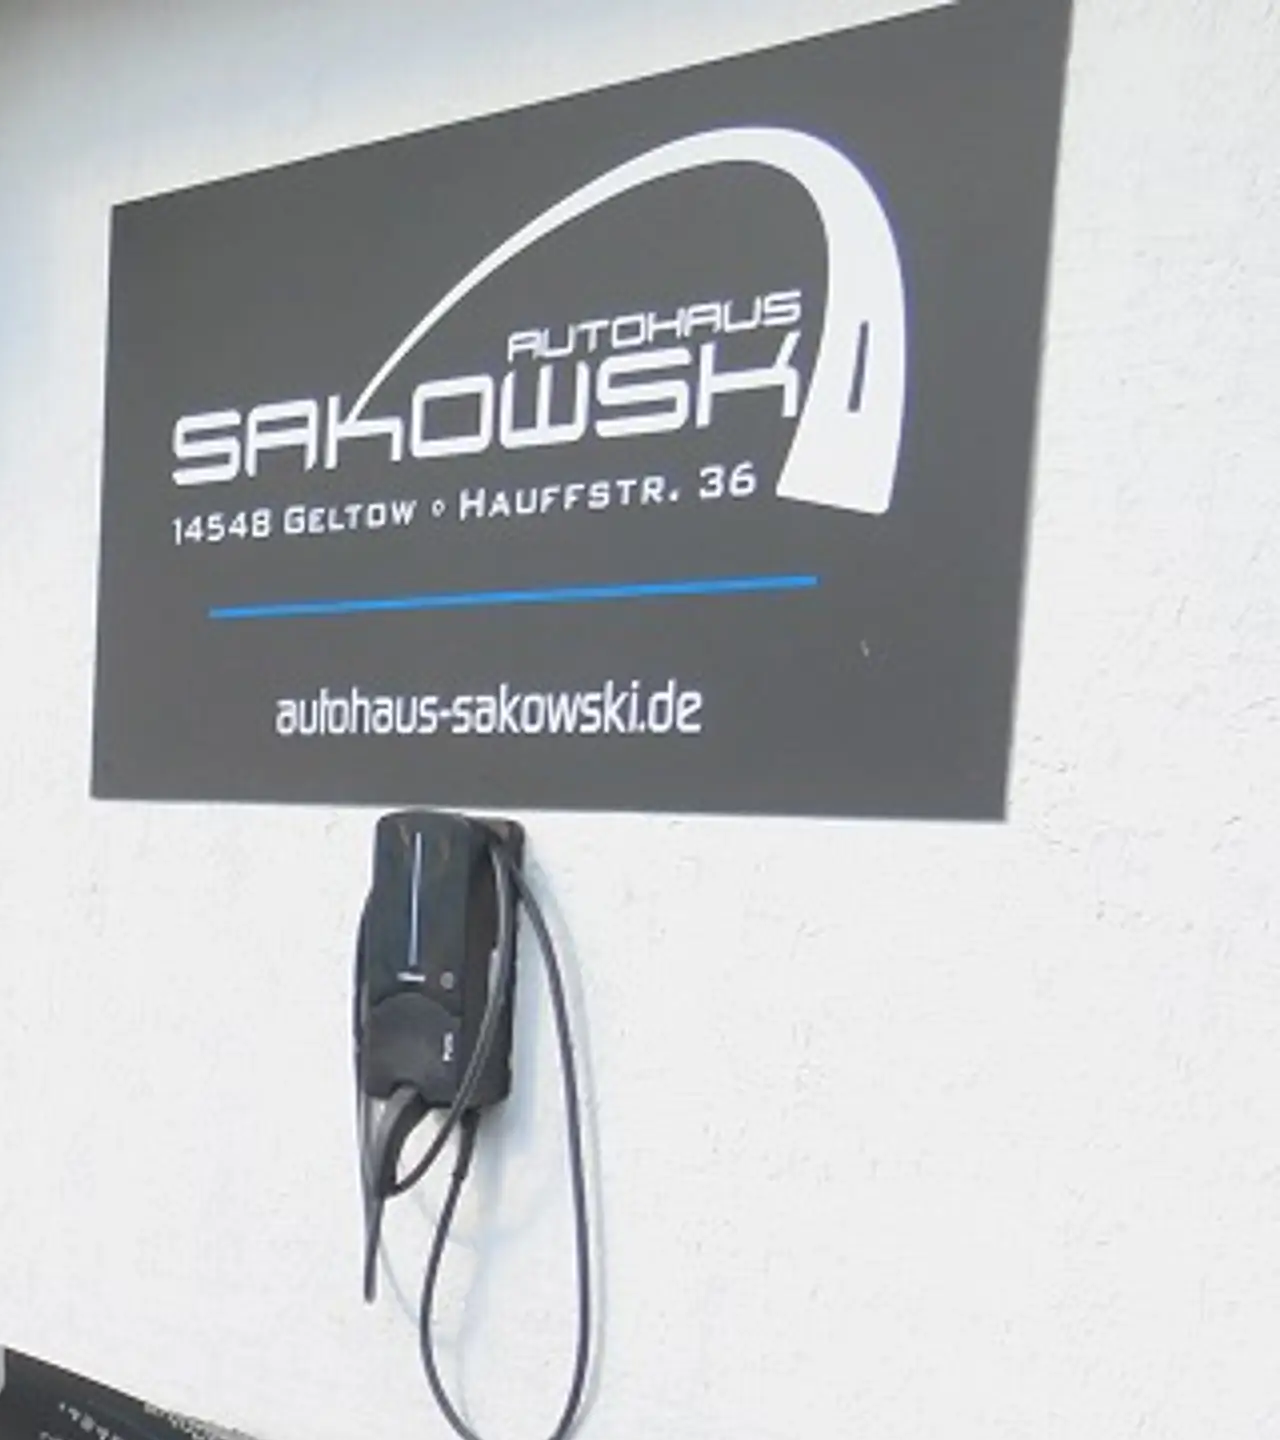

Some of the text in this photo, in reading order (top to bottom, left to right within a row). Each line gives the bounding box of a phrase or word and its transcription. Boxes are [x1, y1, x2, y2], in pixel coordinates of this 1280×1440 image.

[507, 289, 802, 362] AUTOHAUS
[172, 461, 758, 545] 14548 GELTOW HAUFFSTR. 36
[274, 677, 703, 736] autohaus-sakowski.de
